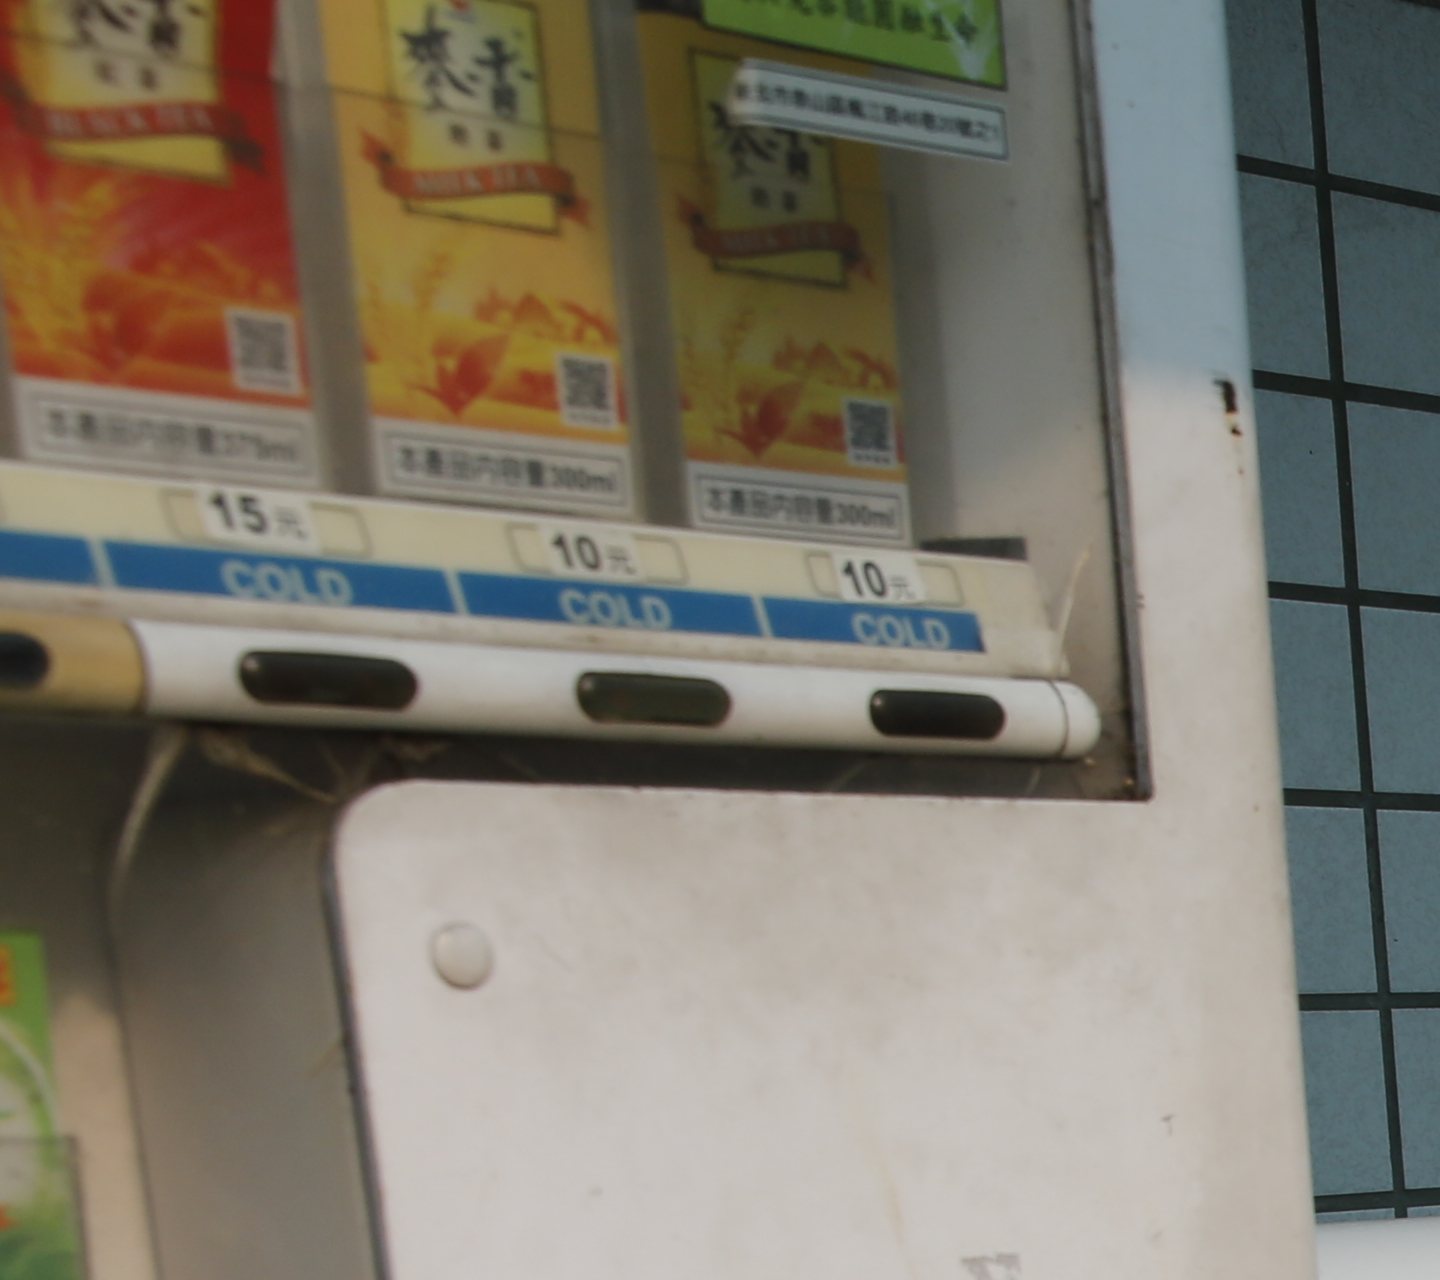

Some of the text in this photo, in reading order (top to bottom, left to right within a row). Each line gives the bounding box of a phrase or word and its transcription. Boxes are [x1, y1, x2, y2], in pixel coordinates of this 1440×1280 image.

[221, 559, 352, 606] COLD
[558, 588, 673, 630] COLD
[851, 612, 951, 650] COLD
